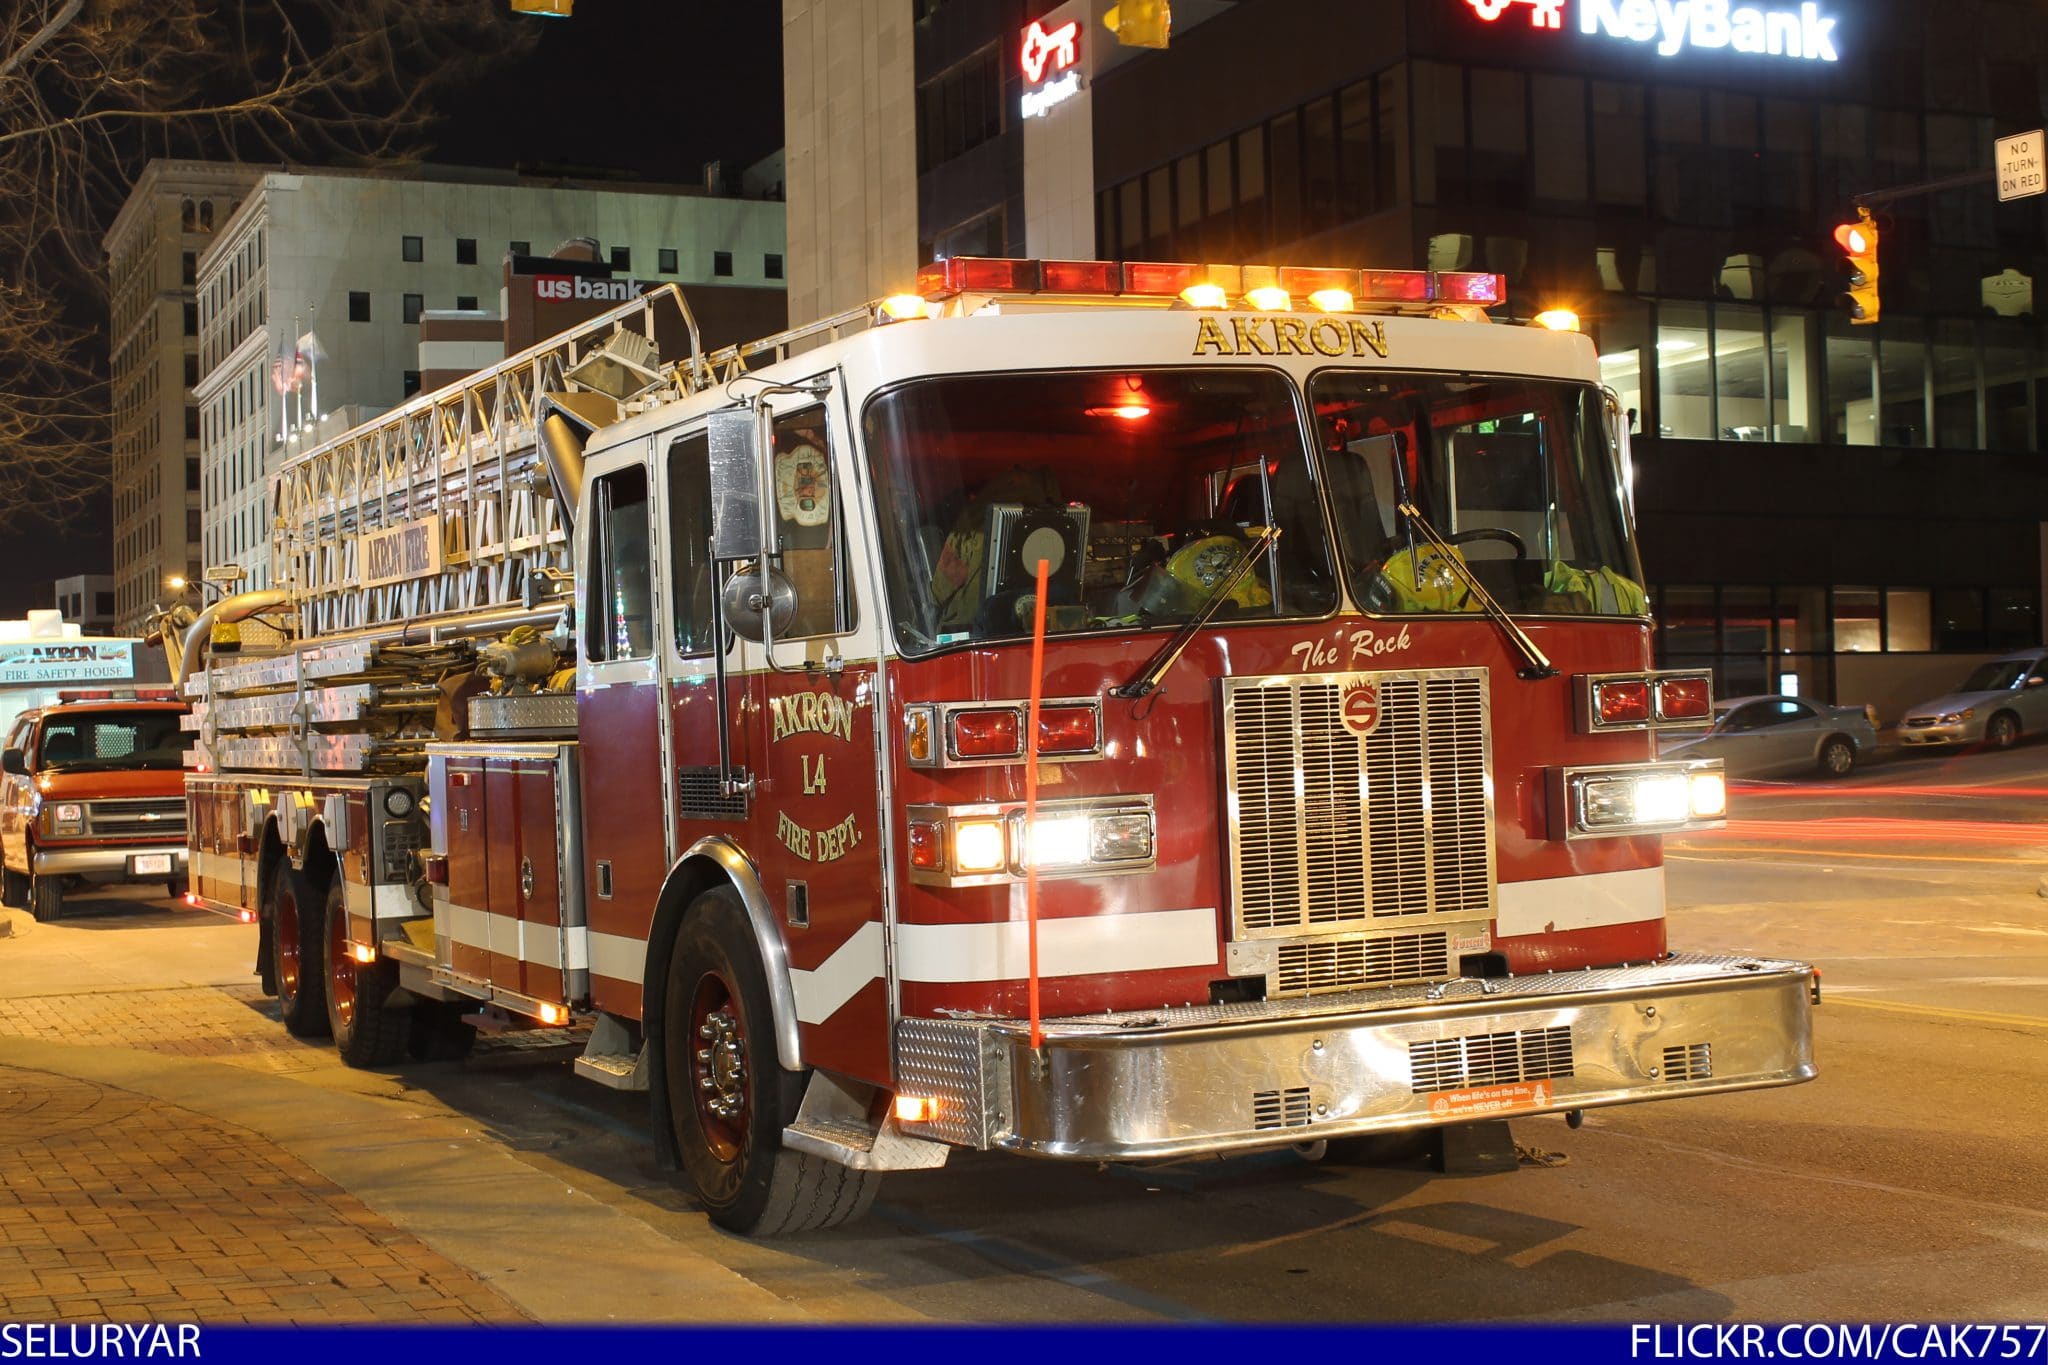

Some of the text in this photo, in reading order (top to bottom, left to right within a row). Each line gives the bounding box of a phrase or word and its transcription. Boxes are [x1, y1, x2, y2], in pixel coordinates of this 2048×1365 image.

[1580, 0, 1838, 61] KeyBank
[2010, 141, 2029, 155] NO
[2002, 173, 2041, 191] ON RED
[1192, 316, 1389, 358] AKRON
[368, 525, 430, 580] AKRON FIRE
[30, 645, 97, 663] AKRON
[1291, 623, 1411, 672] The Rock
[5, 666, 123, 680] FIRE SAFETY HOUSE
[773, 691, 854, 744] AKRON
[801, 753, 827, 796] L4
[776, 810, 862, 862] FIRE DEPT.
[1449, 1094, 1471, 1103] When
[1472, 1090, 1490, 1100] life's
[1491, 1089, 1501, 1098] on
[1502, 1088, 1514, 1096] the
[1473, 1101, 1501, 1112] NEVER
[1501, 1099, 1513, 1107] off
